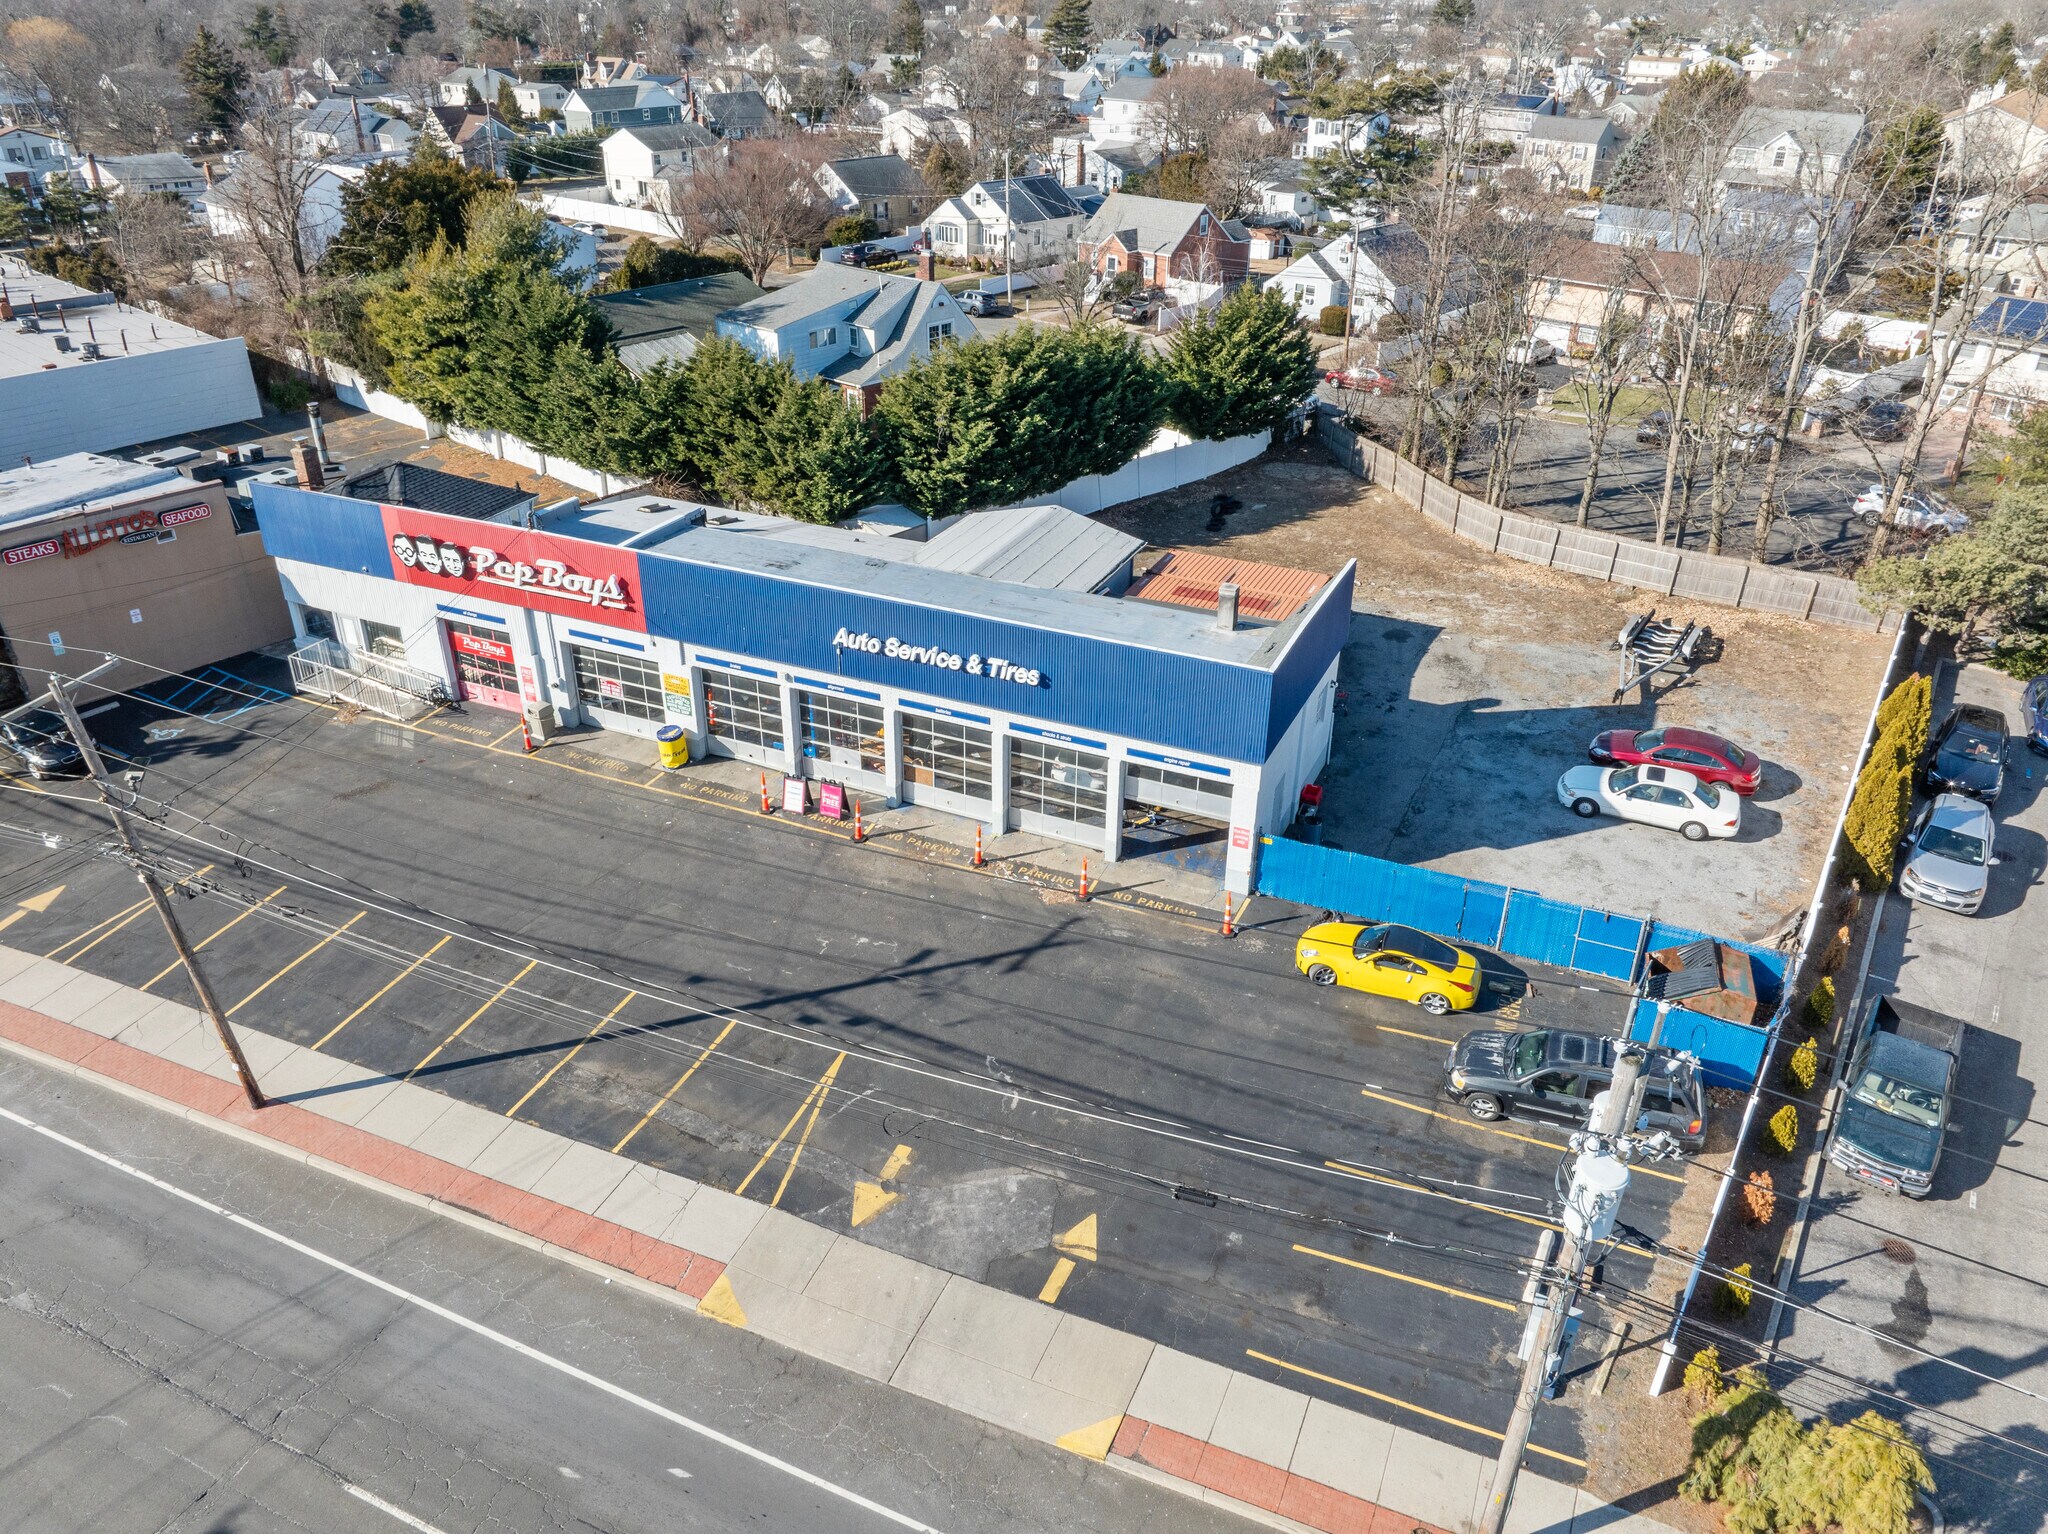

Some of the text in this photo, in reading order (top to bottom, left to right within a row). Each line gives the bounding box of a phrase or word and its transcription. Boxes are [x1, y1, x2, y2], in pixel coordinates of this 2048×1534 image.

[164, 506, 209, 525] SEAFOOD
[62, 510, 158, 560] ALLETTO'S
[123, 531, 158, 544] RESTAURANT
[8, 542, 55, 563] STEAKS
[469, 546, 625, 606] Pep Boys
[461, 636, 506, 657] Pep Boys
[832, 627, 1040, 686] Auto Service & Tires
[432, 719, 492, 737] NO PARKING
[566, 751, 629, 772] NO PARKING
[1163, 756, 1191, 767] engine repair
[680, 782, 749, 803] NO PARKING
[822, 797, 840, 808] FREE
[807, 813, 855, 830] ARKING
[907, 837, 961, 856] PARKING
[1018, 866, 1075, 887] PARKING
[1112, 891, 1198, 917] NO PARKING
